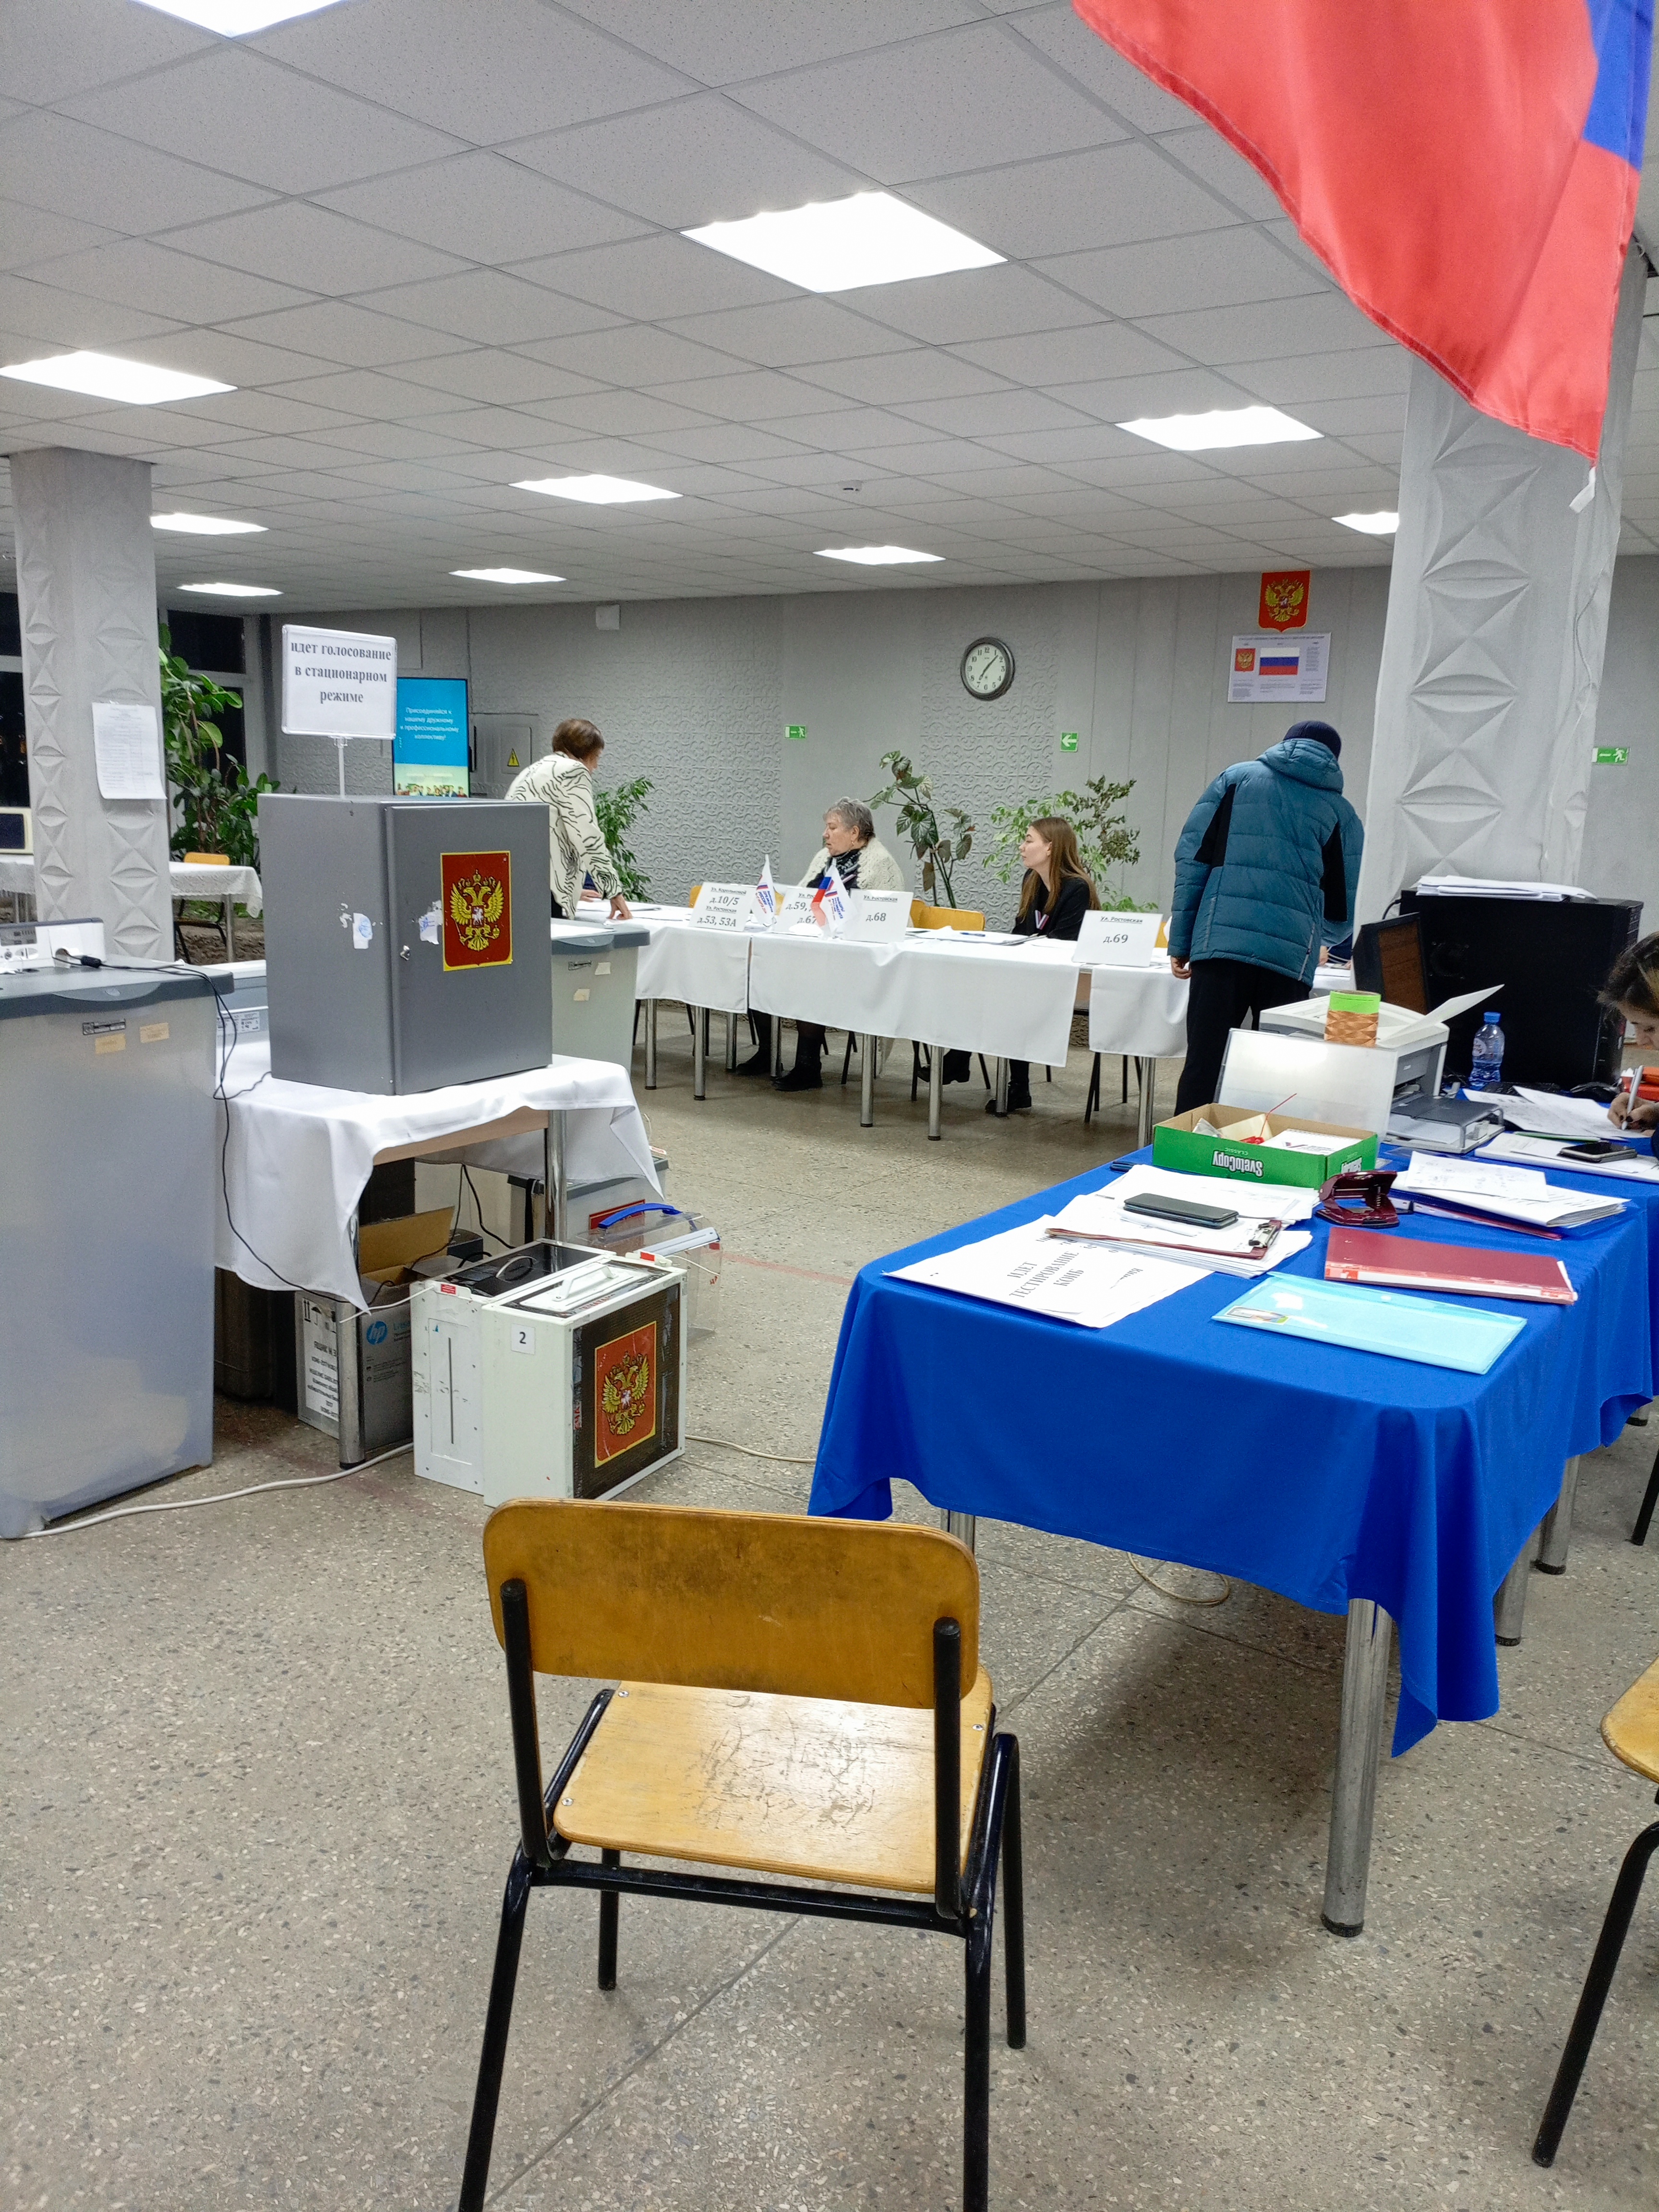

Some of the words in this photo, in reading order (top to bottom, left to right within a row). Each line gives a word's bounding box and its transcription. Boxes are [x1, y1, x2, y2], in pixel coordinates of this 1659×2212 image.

[291, 641, 318, 654] идет
[322, 644, 392, 661] голосование
[295, 666, 301, 675] в
[305, 667, 387, 684] стационарном
[320, 690, 363, 704] режиме
[709, 896, 740, 906] д.10/5
[785, 902, 807, 912] д.59,
[697, 915, 717, 926] д.53,
[719, 917, 736, 927] 53А
[866, 913, 886, 922] д.68
[1103, 934, 1128, 944] д.69
[1212, 1151, 1263, 1177] SvetoCopy
[1007, 1261, 1037, 1278] ИДЕТ
[1009, 1251, 1079, 1298] ТЕСТИРОВАНИЕ
[1053, 1269, 1084, 1286] КОИБ
[519, 1332, 527, 1344] 2
